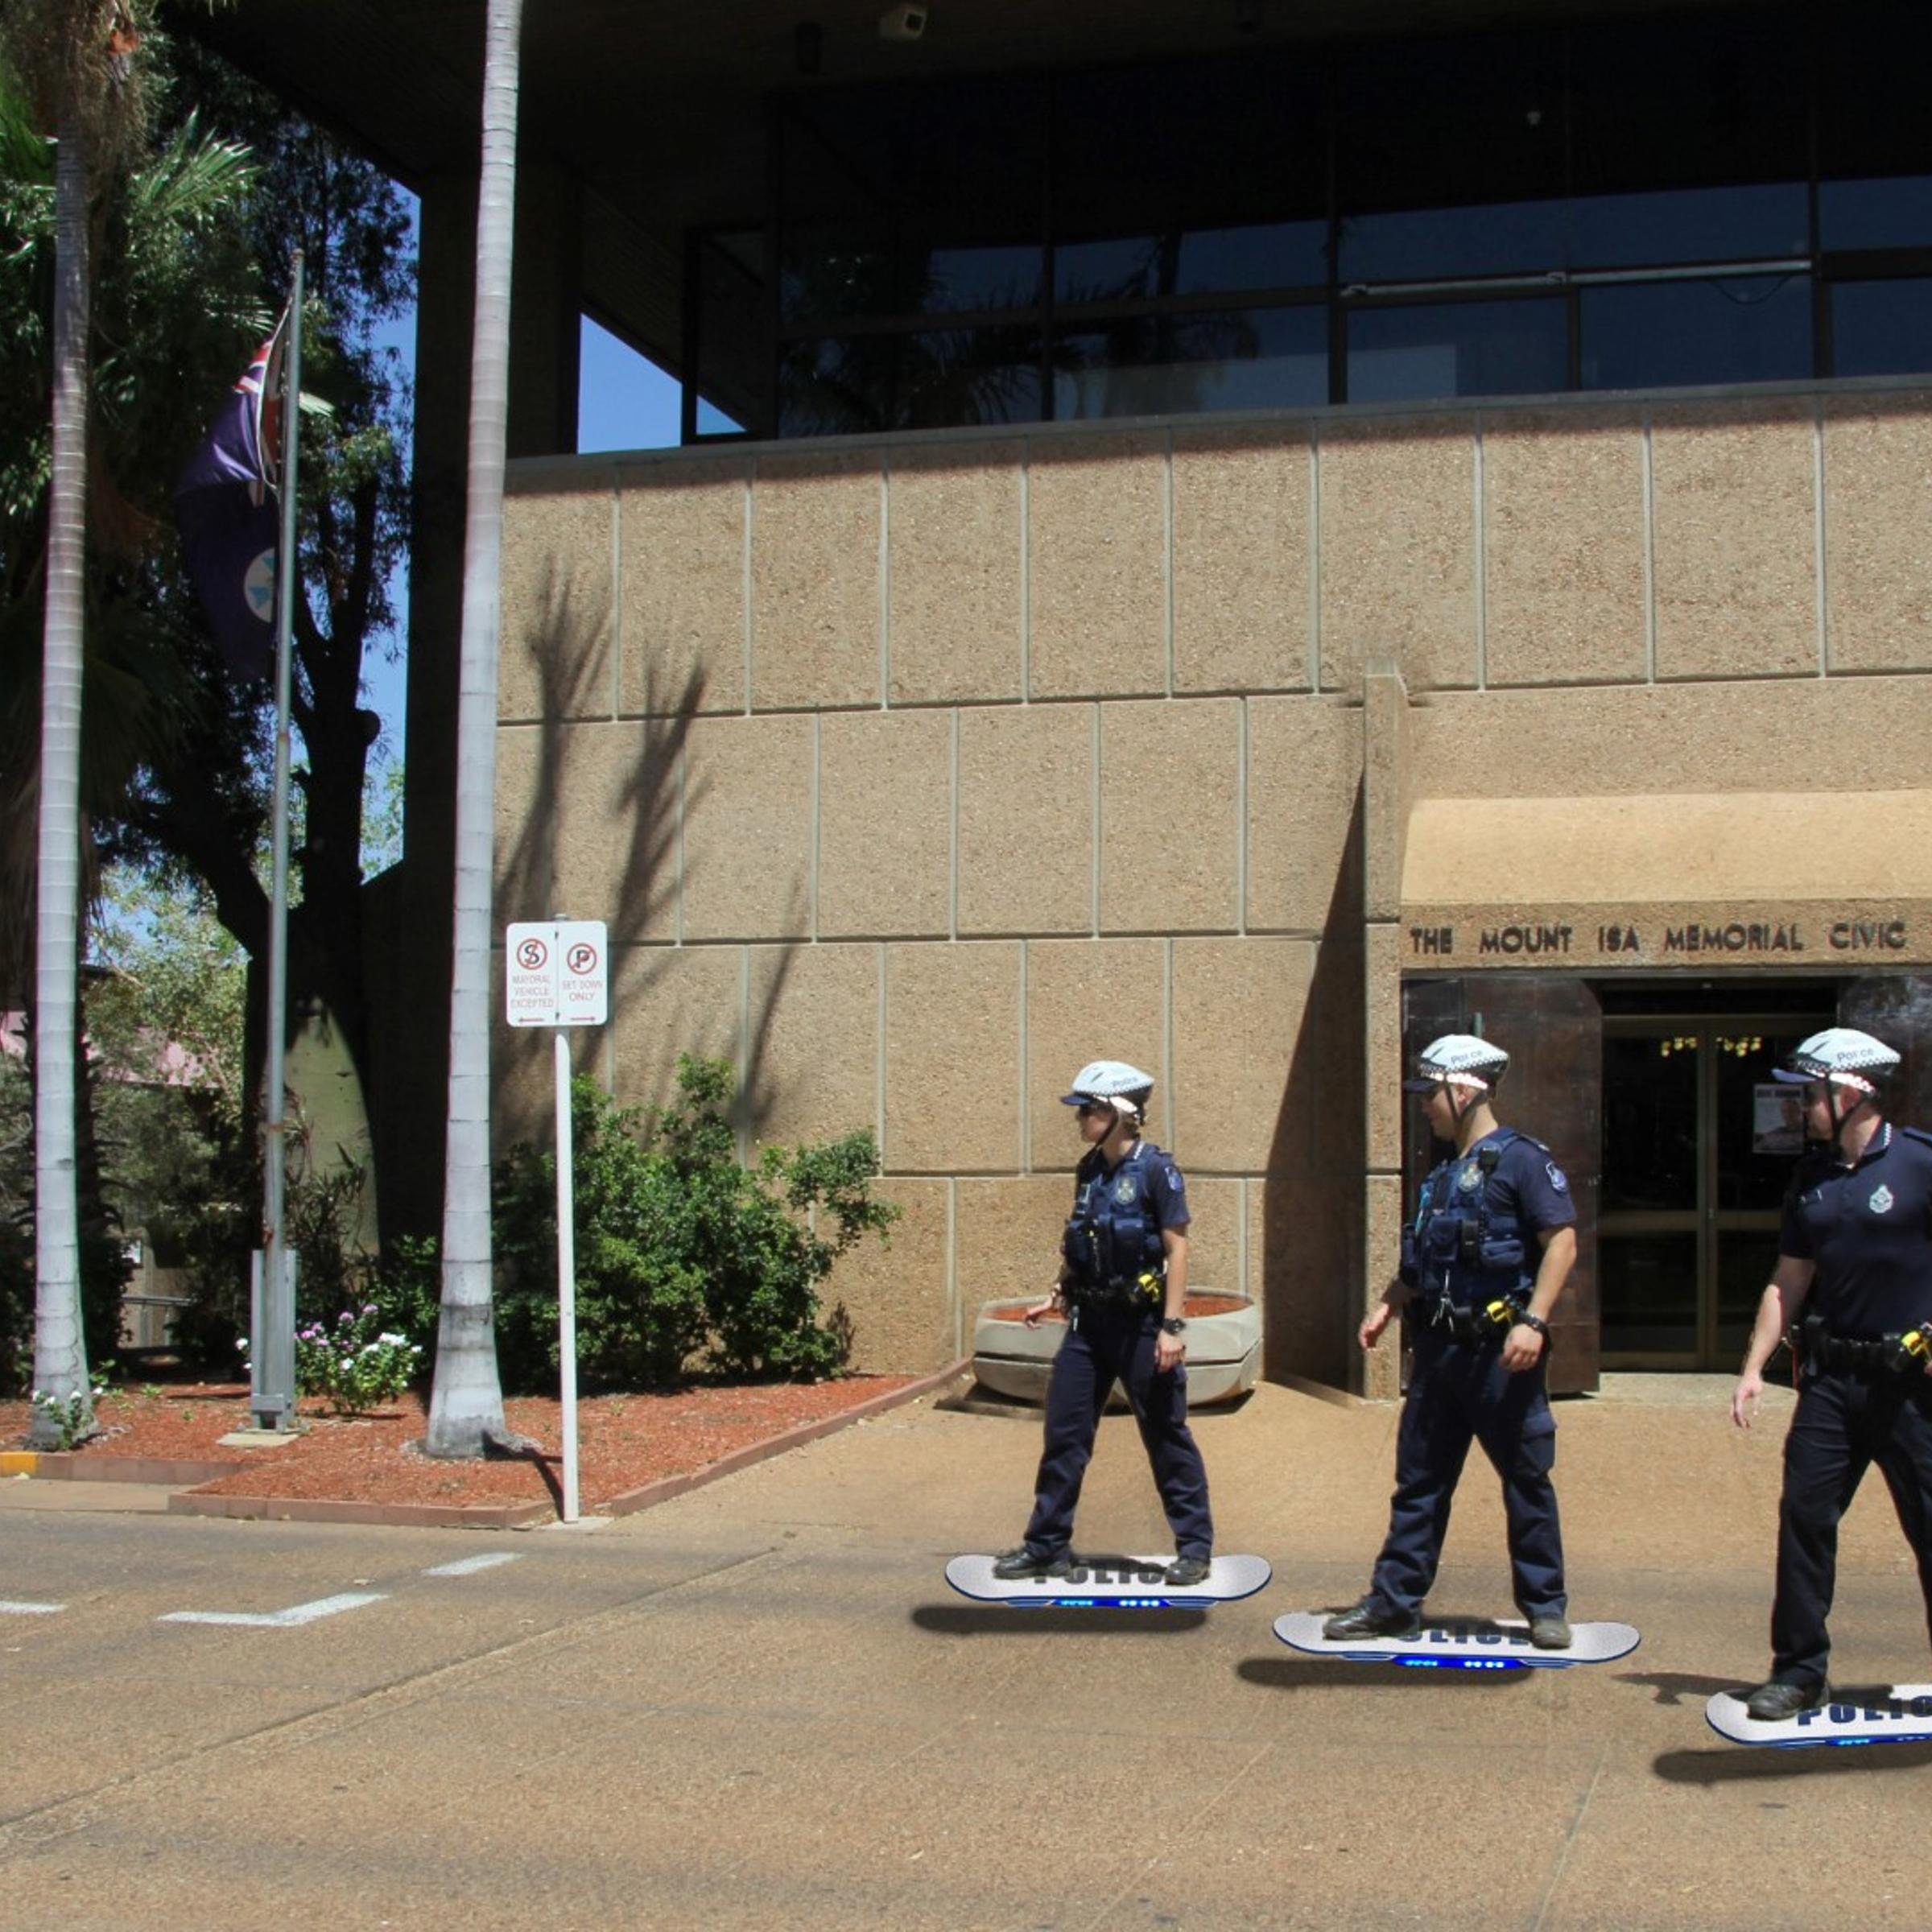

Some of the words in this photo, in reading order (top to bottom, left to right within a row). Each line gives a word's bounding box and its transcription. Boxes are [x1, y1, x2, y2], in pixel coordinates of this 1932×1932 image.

[1410, 927, 1452, 954] THE
[1479, 926, 1572, 954] MOUNT
[1598, 925, 1640, 952] ISA
[1664, 923, 1803, 952] MEMORIAL
[1829, 923, 1905, 950] CIVIC
[562, 980, 577, 989] SET
[580, 980, 603, 989] DOWN
[514, 987, 549, 996] VEHICLE
[568, 992, 595, 1001] ONLY
[510, 998, 554, 1008] EXCEPTED
